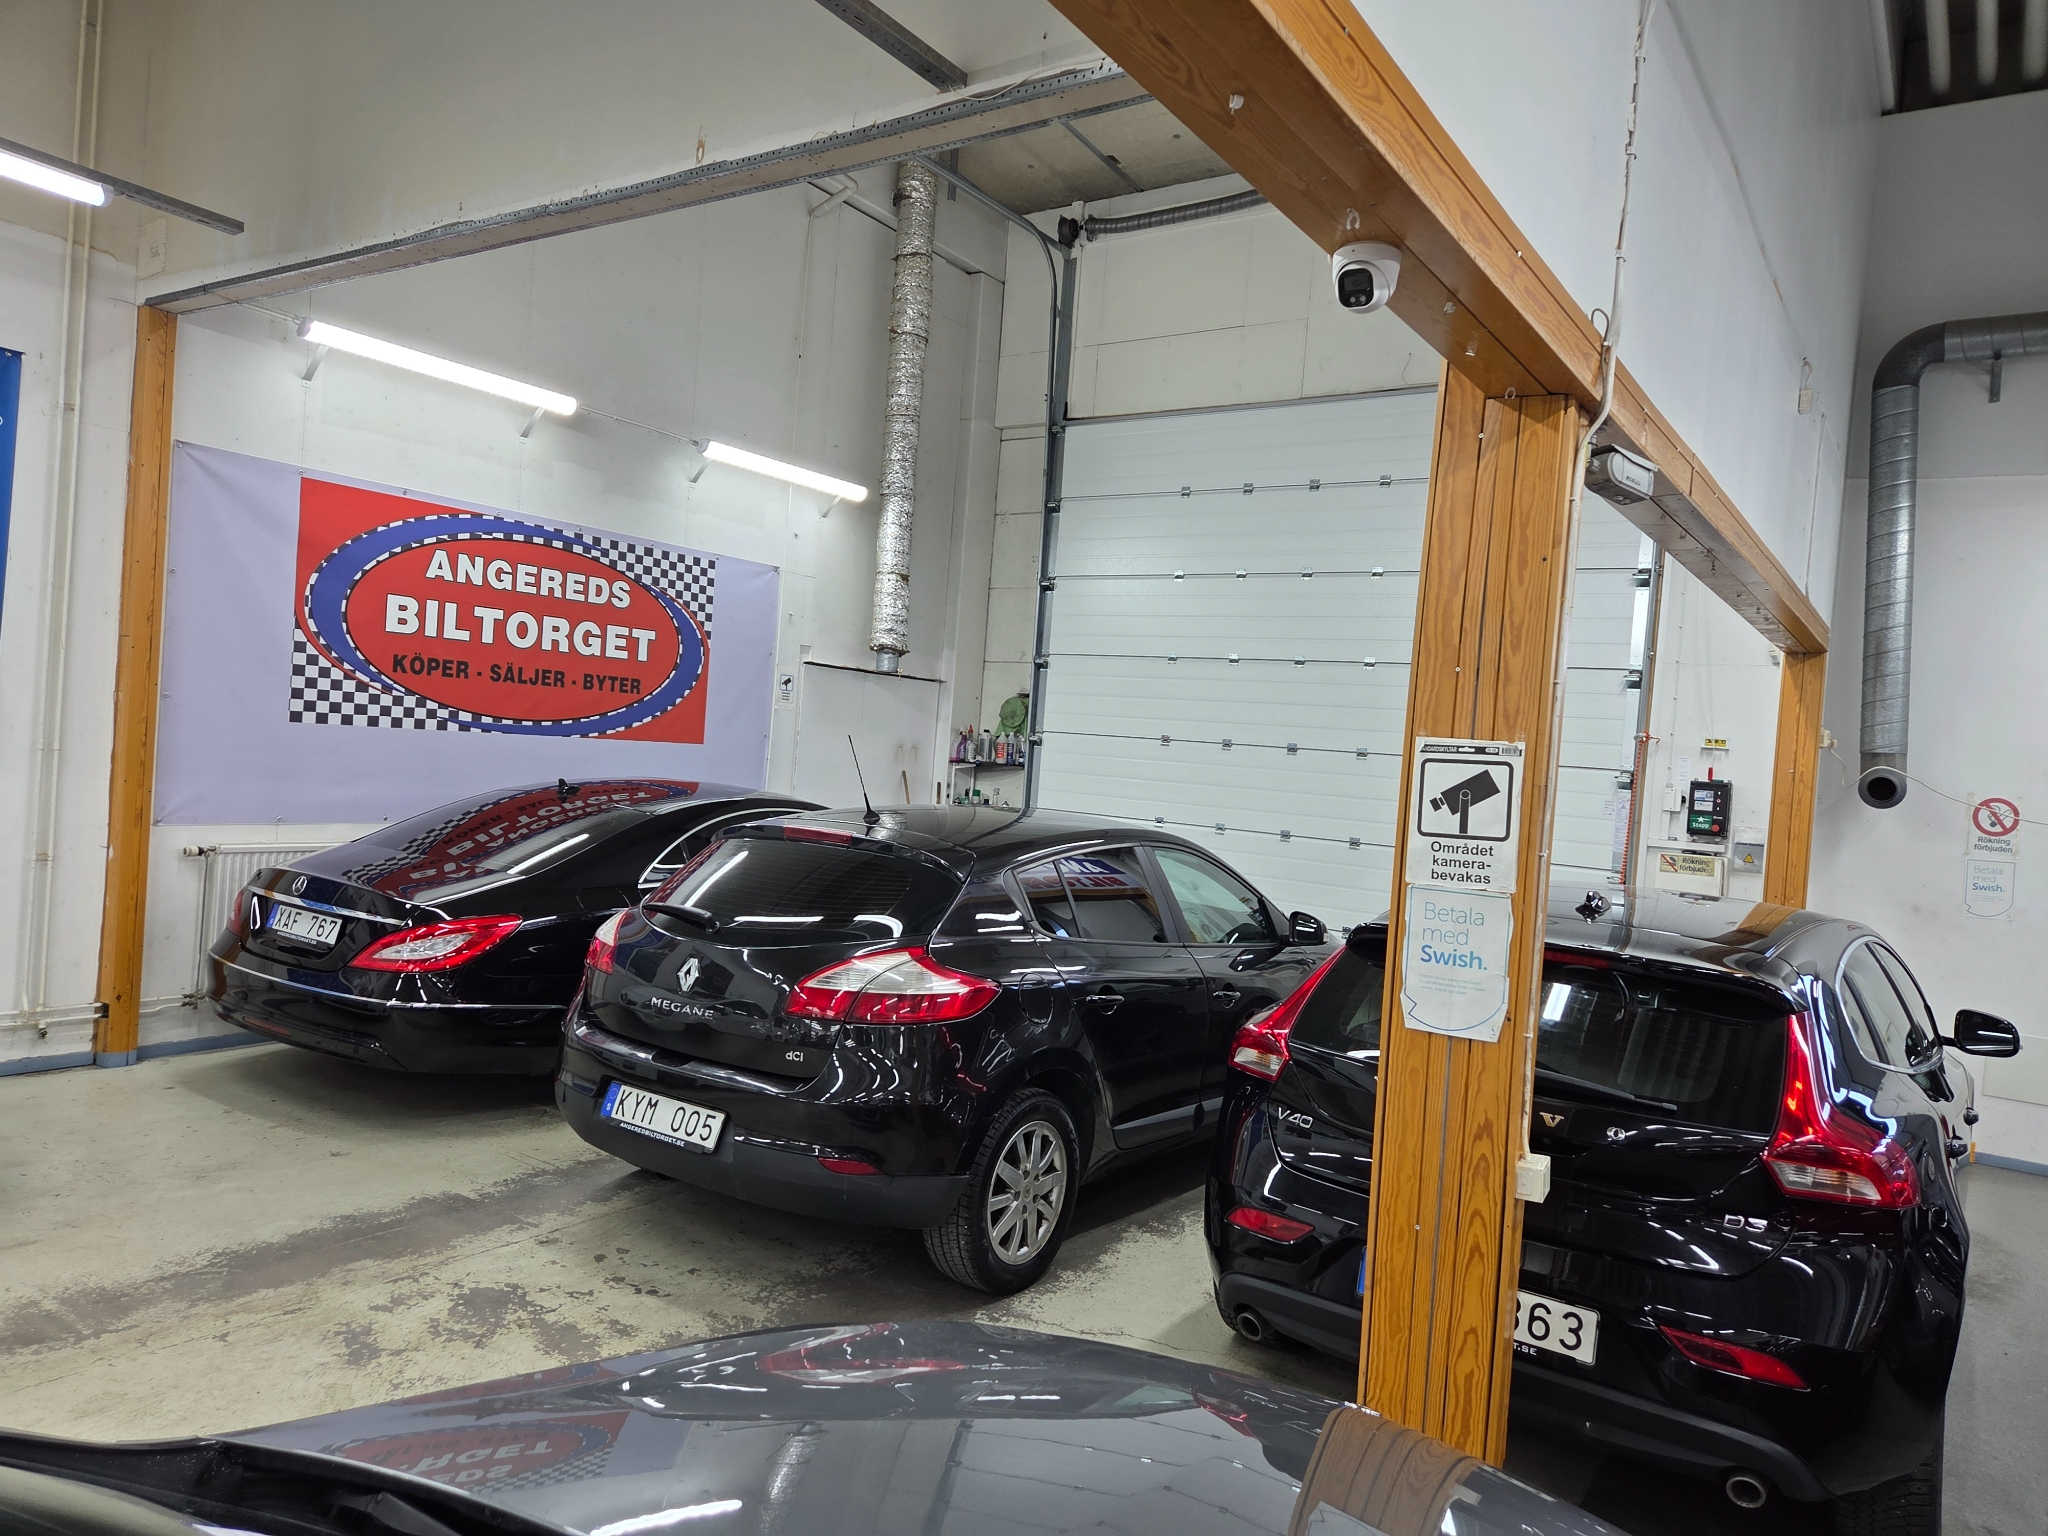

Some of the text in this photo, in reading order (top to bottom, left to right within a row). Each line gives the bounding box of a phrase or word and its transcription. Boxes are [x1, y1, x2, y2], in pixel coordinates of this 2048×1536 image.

[425, 549, 631, 609] ANGEREDS
[385, 593, 656, 662] BILTORGET
[392, 653, 641, 695] KÖPER SÄLJER BYTER
[1431, 841, 1494, 856] Området
[1974, 844, 2013, 853] förbjuden
[1978, 836, 2011, 846] Rökning
[1433, 855, 1491, 870] kamera-
[1682, 857, 1710, 867] Rökning
[1973, 865, 2003, 875] Betala
[1431, 868, 1491, 884] bevakas
[1973, 875, 1996, 883] med
[1972, 882, 2005, 893] Swish.
[275, 907, 302, 931] XAF
[307, 915, 338, 940] 767
[1424, 902, 1485, 926] Betala
[1423, 927, 1469, 946] med
[1420, 944, 1488, 971] Swish.
[651, 997, 714, 1020] MEGANE
[606, 1089, 717, 1141] S KYM 005
[1278, 1106, 1314, 1129] V40
[1514, 1297, 1583, 1351] 63
